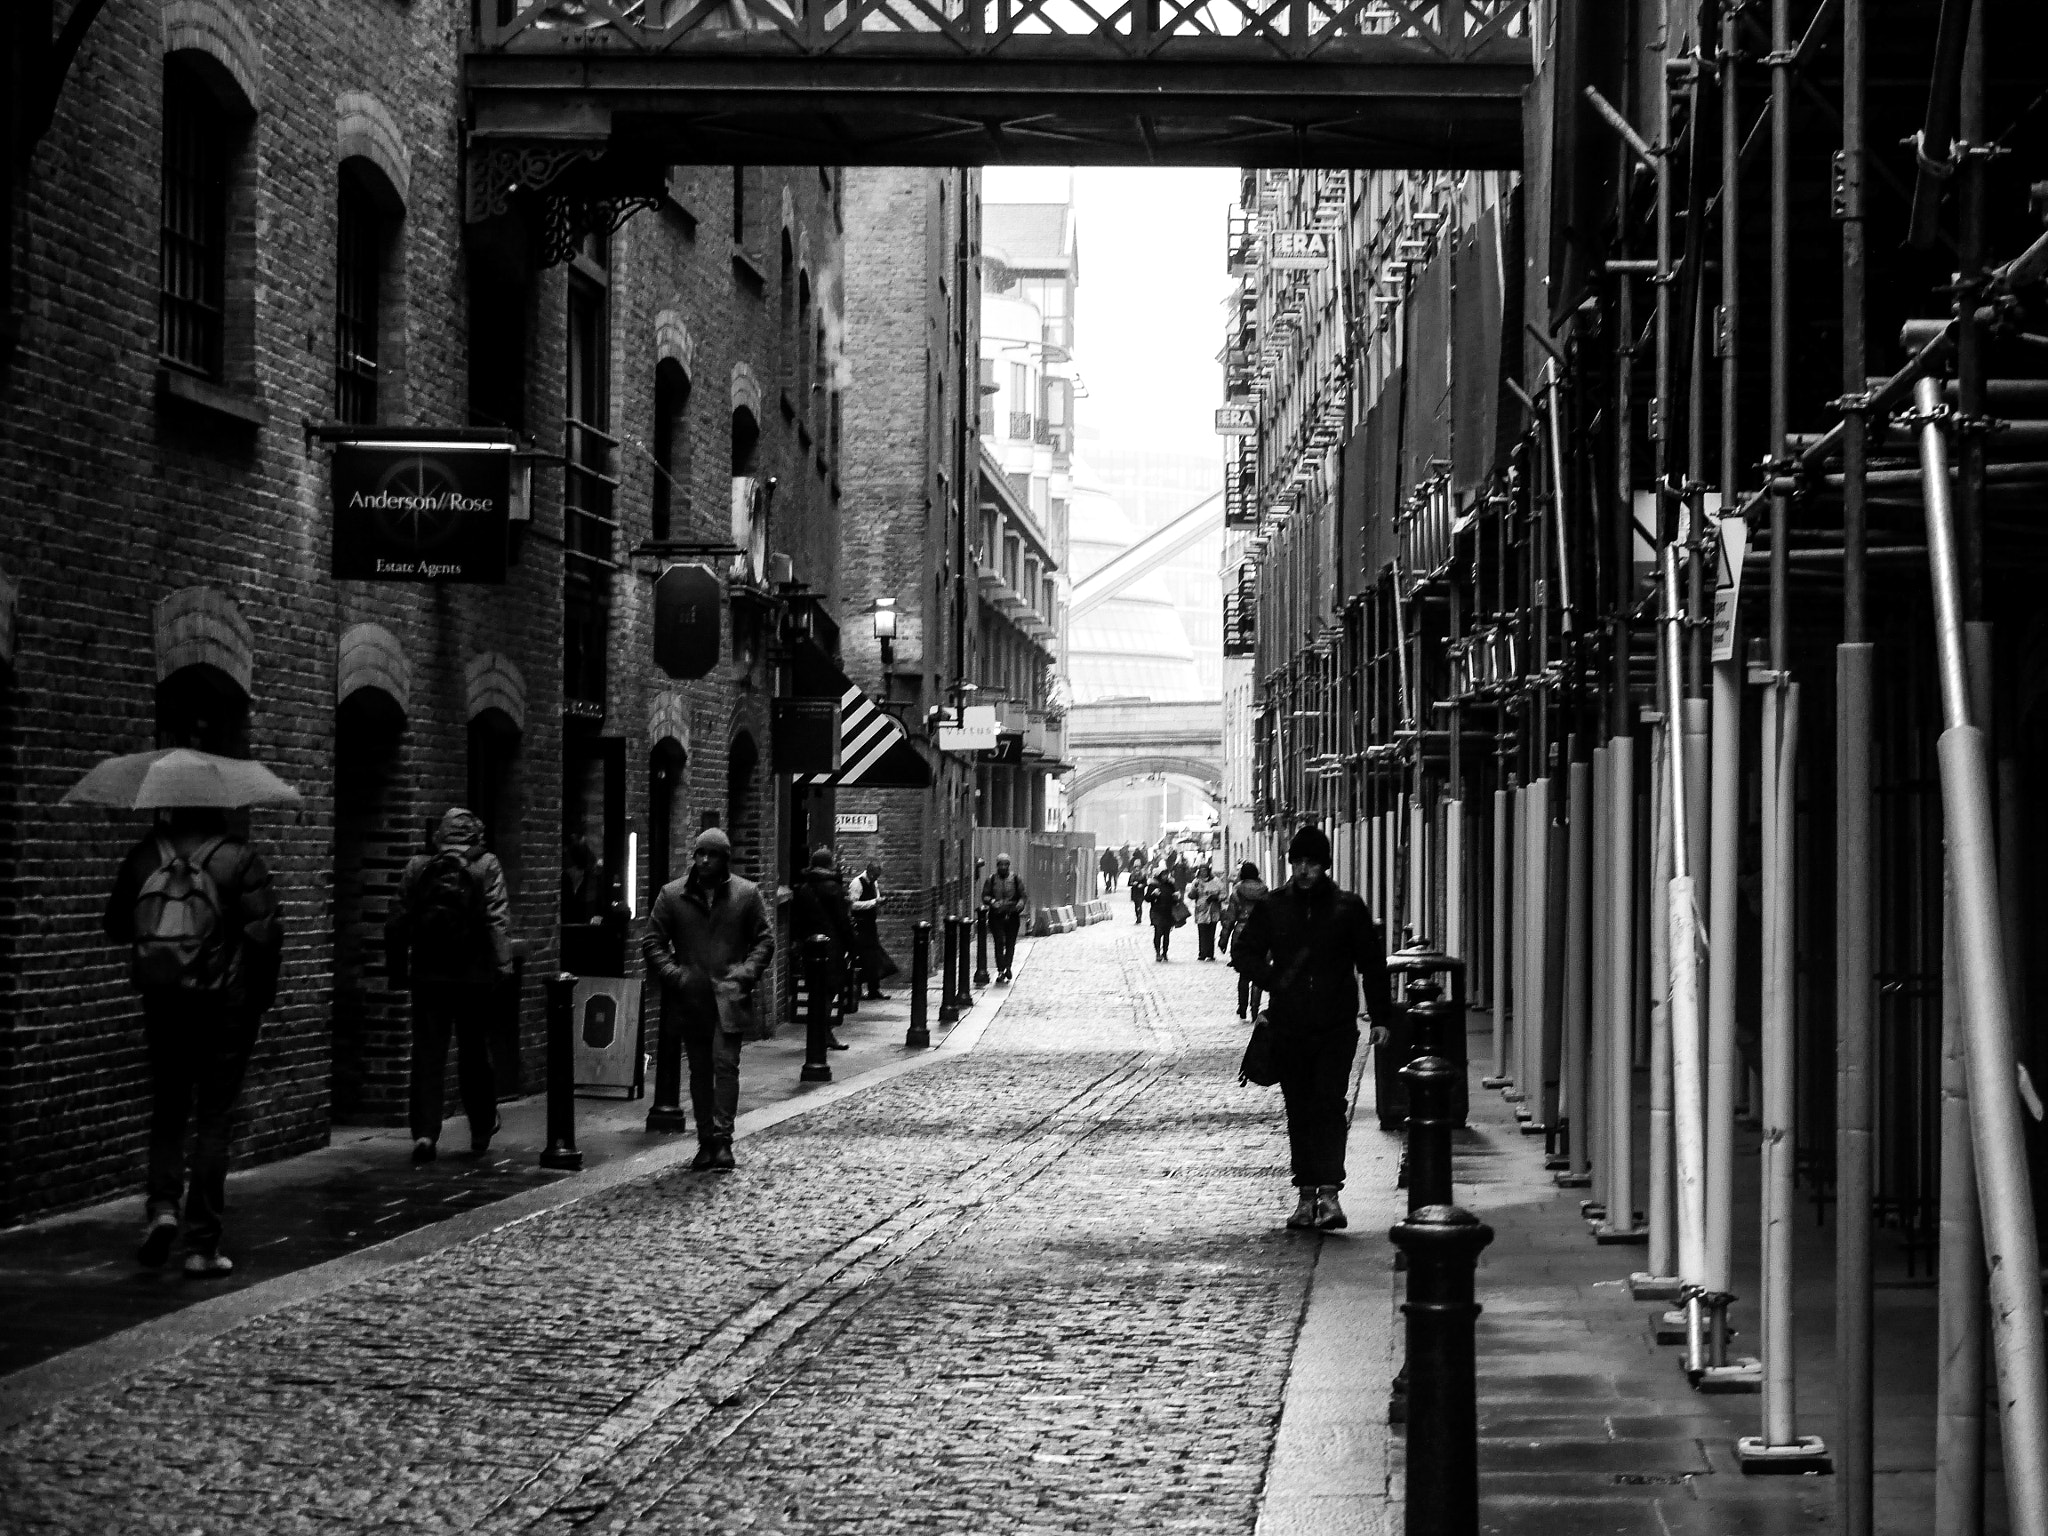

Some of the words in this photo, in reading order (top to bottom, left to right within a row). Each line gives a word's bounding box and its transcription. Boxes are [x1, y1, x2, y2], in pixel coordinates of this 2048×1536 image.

[1281, 233, 1325, 253] ERA
[376, 559, 414, 573] Estate
[417, 560, 461, 578] Agents
[835, 816, 867, 825] STREET
